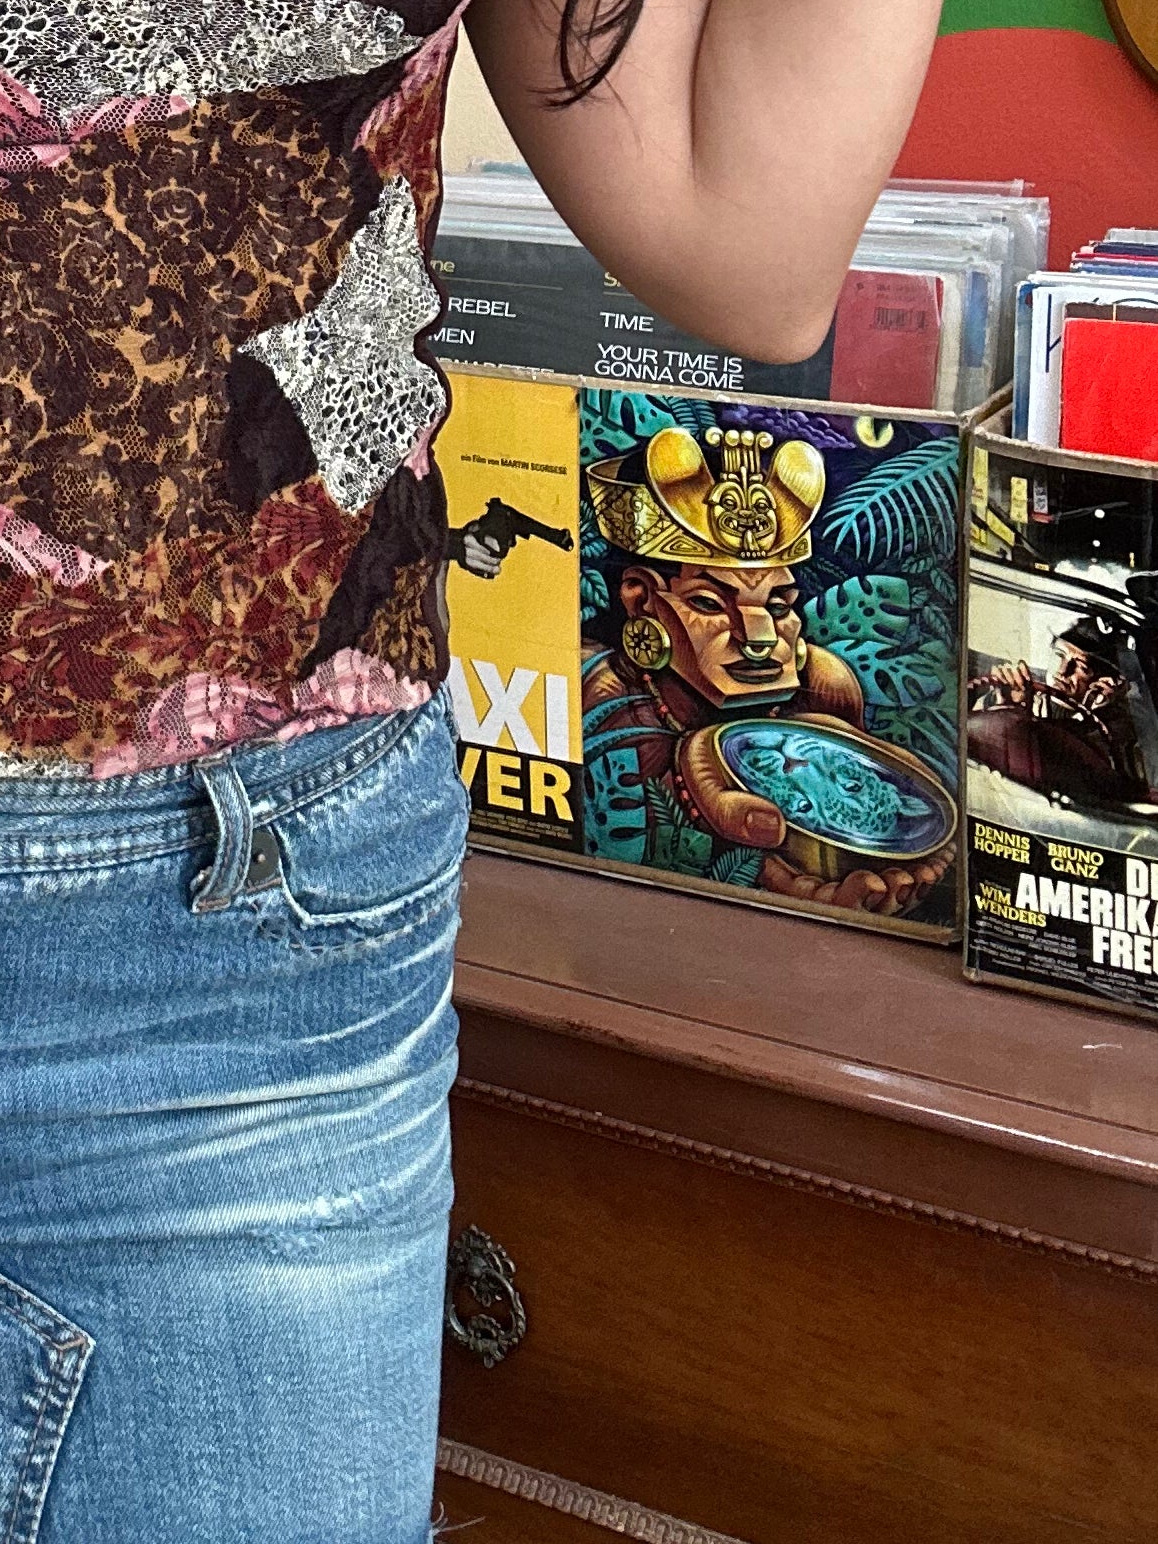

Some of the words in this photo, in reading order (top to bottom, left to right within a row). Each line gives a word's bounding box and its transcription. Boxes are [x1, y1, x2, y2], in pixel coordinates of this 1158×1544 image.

[448, 297, 517, 318] REBEL
[599, 311, 654, 333] TIME
[597, 342, 658, 364] YOUR
[663, 350, 719, 371] TIME
[723, 356, 743, 374] IS
[594, 359, 674, 383] GONNA
[678, 368, 745, 391] COME
[973, 835, 1031, 865] HOPPER
[974, 822, 1031, 850] DENNIS
[1047, 842, 1105, 867] BRUNO
[1050, 857, 1100, 880] GANZ
[979, 882, 1012, 906] WIM
[1015, 872, 1158, 940] AMERIK
[974, 894, 1047, 928] WENDERS
[1092, 925, 1158, 976] FRE
